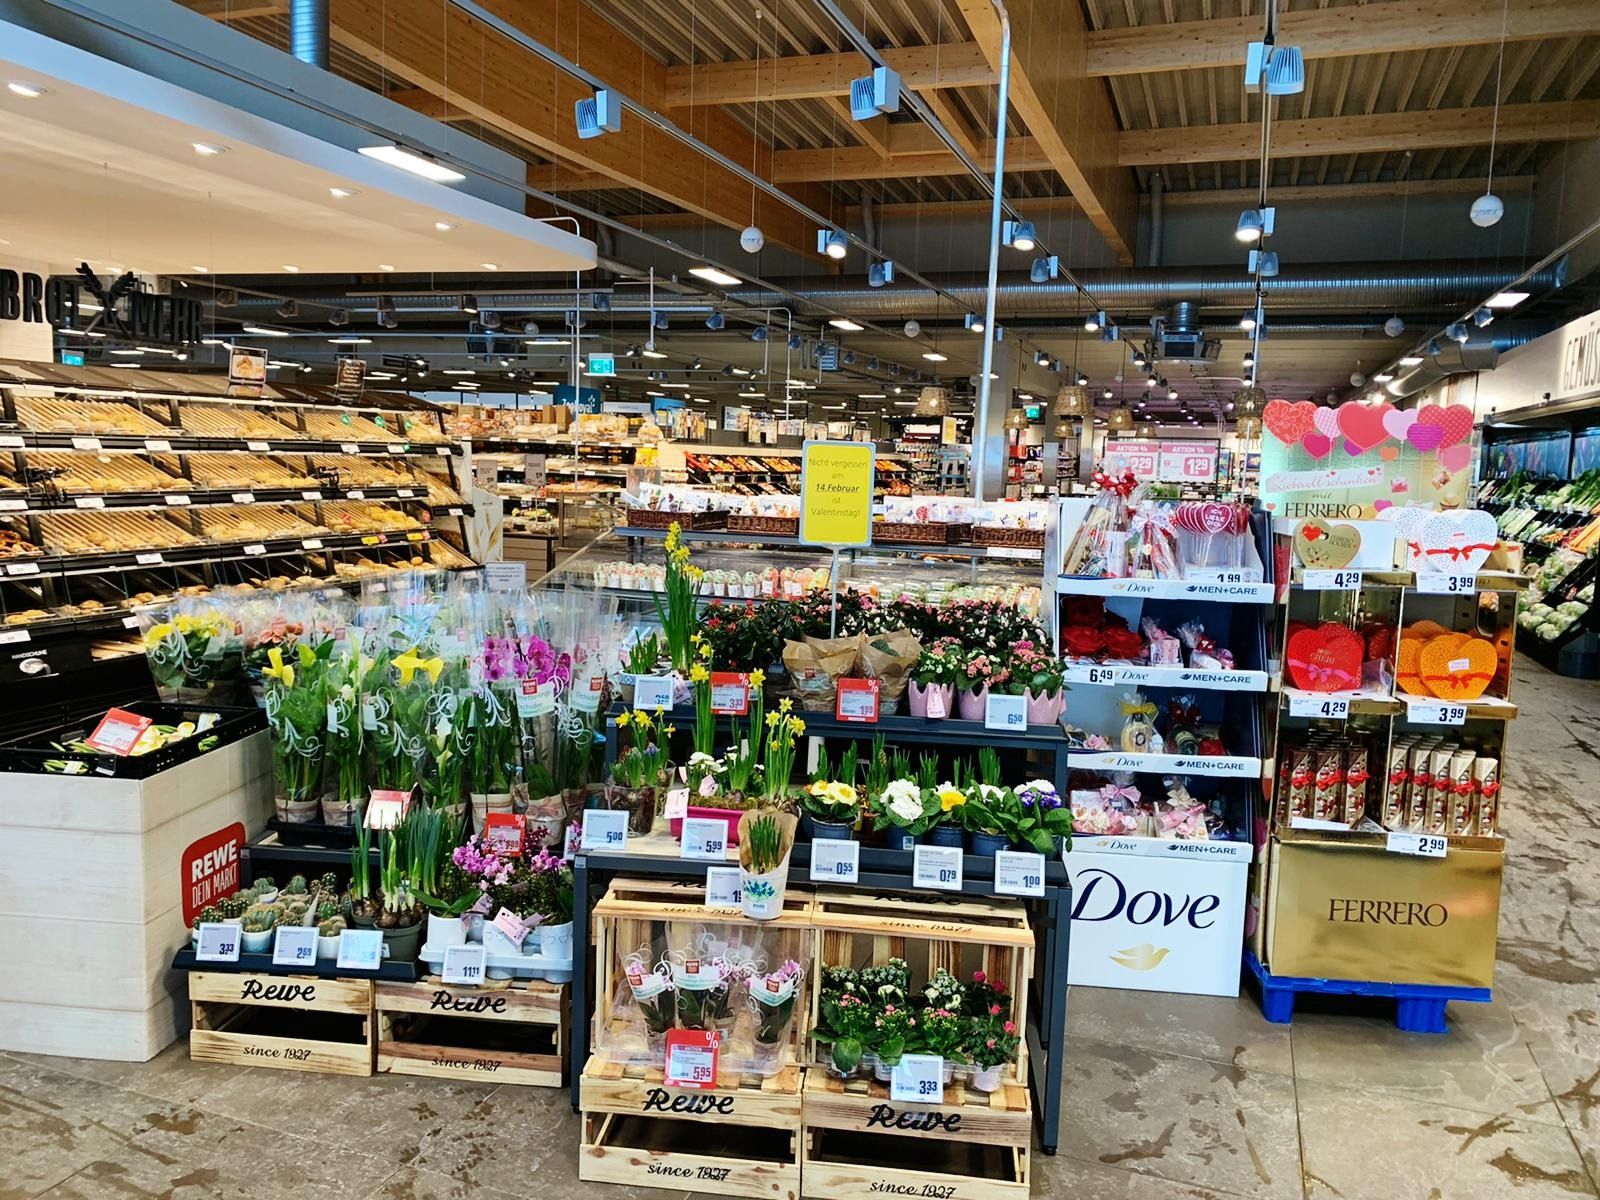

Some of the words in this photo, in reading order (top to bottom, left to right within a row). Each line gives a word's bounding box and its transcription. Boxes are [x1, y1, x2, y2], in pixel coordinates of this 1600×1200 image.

[1563, 318, 1600, 391] GEMÜS
[808, 458, 829, 467] Nicht
[831, 460, 868, 469] vergessen
[1187, 457, 1209, 475] 1.29
[1326, 475, 1376, 488] schenken
[811, 507, 861, 519] Valentinstag!
[1285, 502, 1363, 519] FERRERO
[1334, 572, 1359, 587] 4.29
[1448, 576, 1473, 592] 3.99
[1126, 583, 1154, 593] Dove
[1199, 586, 1258, 595] MEN+CARE
[1089, 668, 1113, 683] 6.49
[1121, 671, 1149, 681] Dove
[1193, 674, 1252, 684] MEN+CARE
[1321, 702, 1347, 716] 4.29
[1439, 708, 1465, 722] 3.99
[1116, 757, 1143, 767] Dove
[1187, 761, 1245, 770] MEN+CARE
[606, 831, 623, 844] 5.00
[1418, 837, 1445, 853] 2.99
[705, 840, 723, 853] 5.99
[1110, 840, 1137, 850] Dove
[1179, 845, 1238, 855] MEN+CARE
[192, 838, 237, 883] REWE
[836, 862, 854, 875] 0.55
[939, 869, 957, 882] 0.79
[192, 878, 211, 909] DEIN
[213, 862, 237, 896] MARKT
[1022, 875, 1041, 888] 1.00
[1071, 868, 1220, 929] Dove
[1328, 898, 1448, 927] FERRERO
[218, 943, 235, 955] 3.33
[241, 979, 316, 1001] Rewe
[430, 990, 507, 1013] Rewe
[243, 1044, 281, 1058] since
[284, 1047, 311, 1061] 1927
[432, 1056, 471, 1069] since
[473, 1058, 502, 1072] 1927
[693, 1066, 711, 1080] 5.95
[919, 1080, 938, 1095] 3.33
[642, 1088, 735, 1115] Rewe
[867, 1104, 962, 1132] Rewe
[647, 1162, 694, 1178] since
[696, 1166, 732, 1181] 1927
[870, 1180, 919, 1195] since
[921, 1184, 957, 1200] 1927
